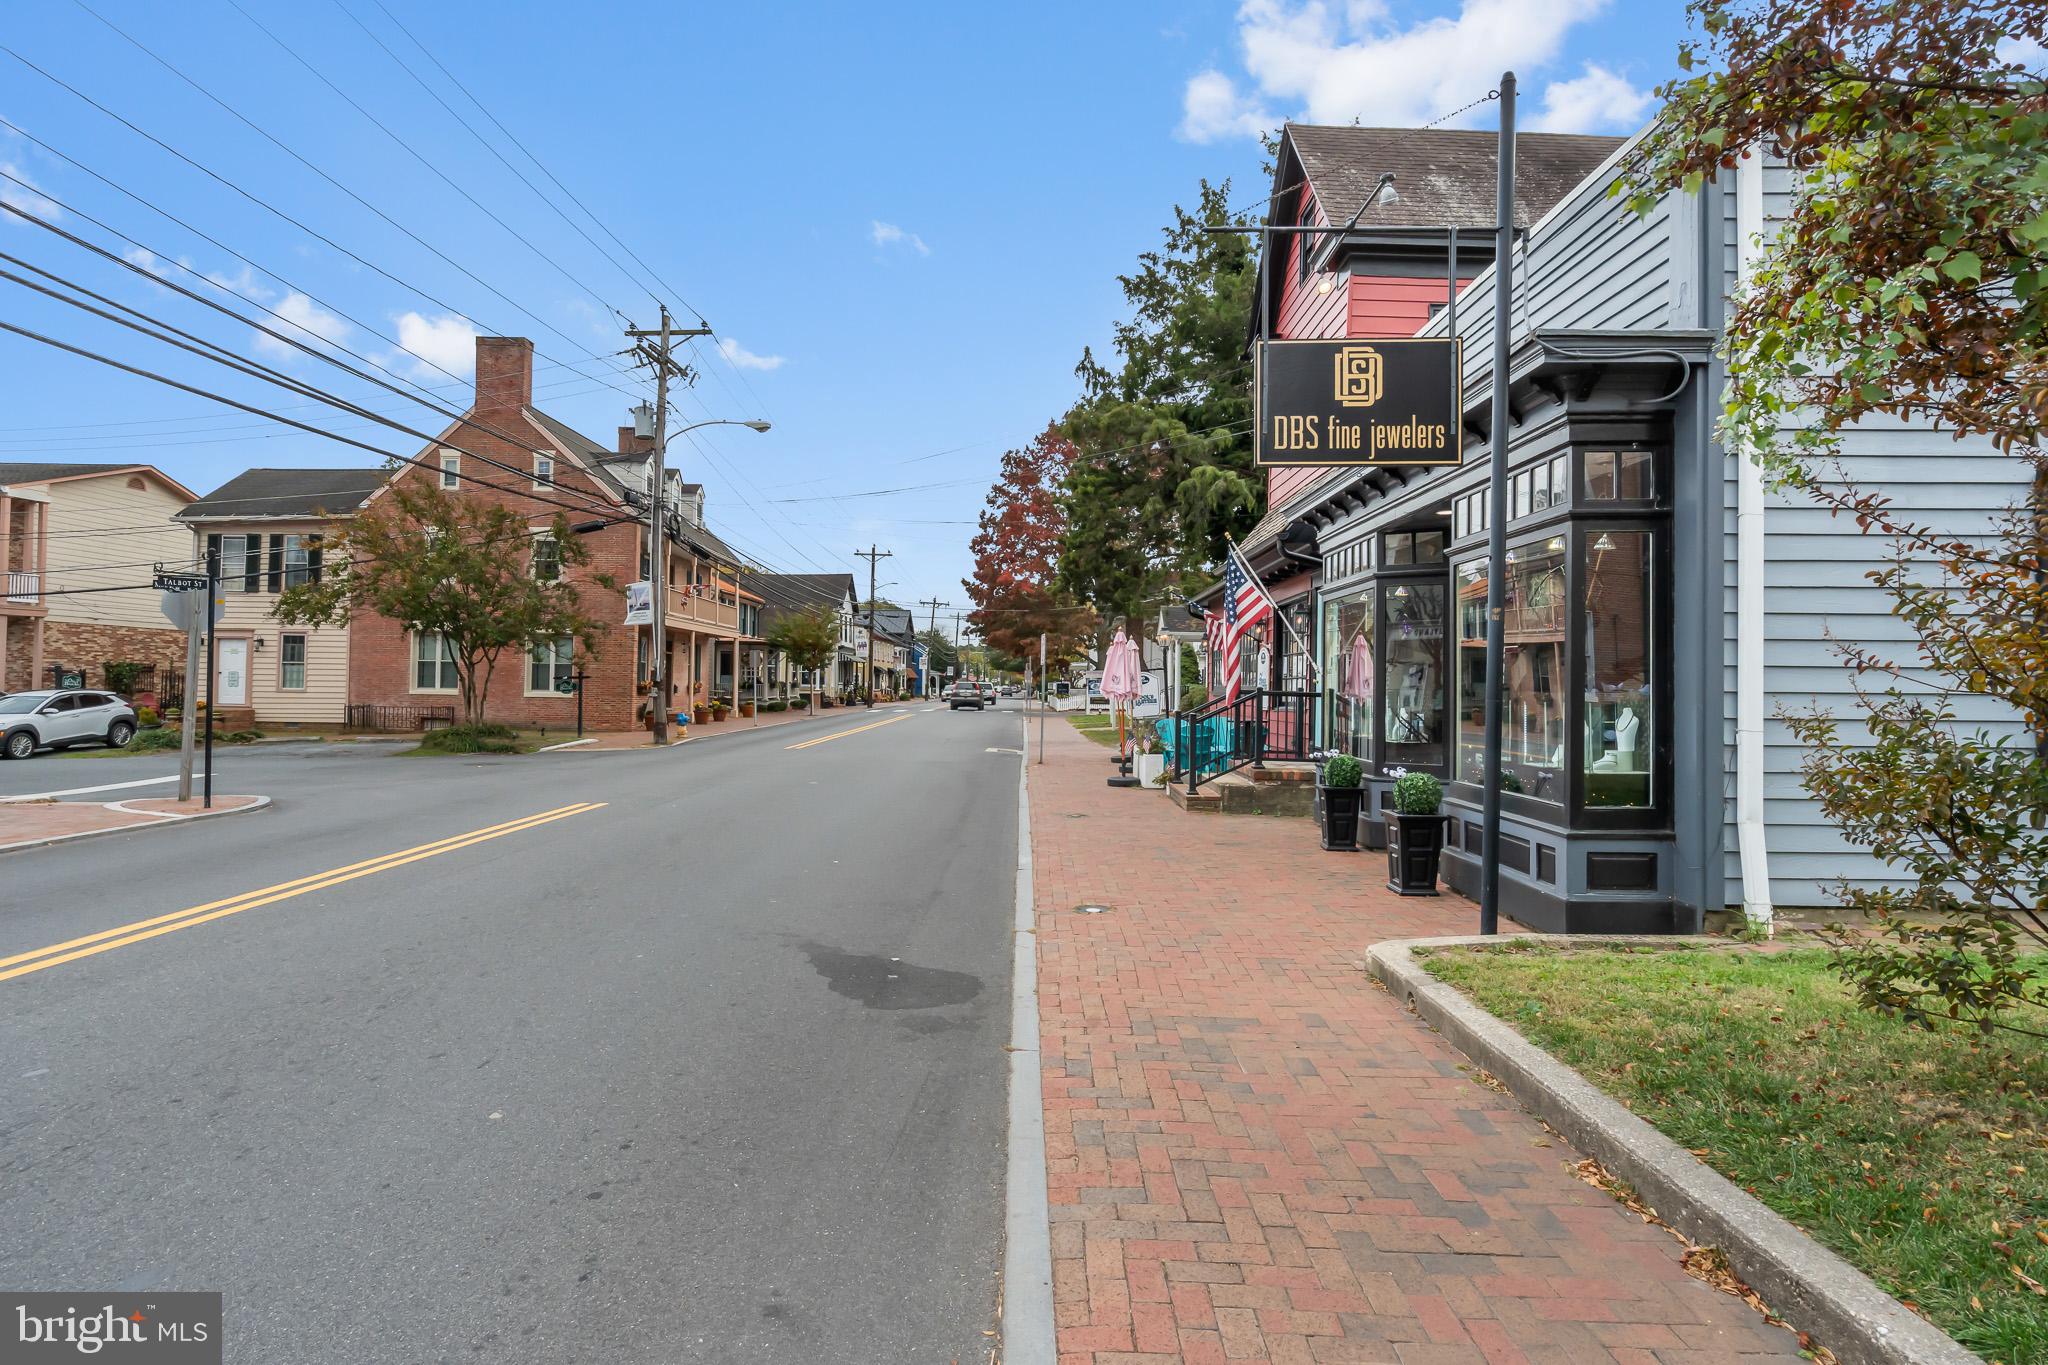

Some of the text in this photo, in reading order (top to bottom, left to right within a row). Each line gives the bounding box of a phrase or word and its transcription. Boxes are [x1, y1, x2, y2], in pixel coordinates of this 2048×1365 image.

[1273, 414, 1445, 460] DBS fine jewelers
[163, 577, 192, 587] TALBOT
[193, 580, 202, 588] ST
